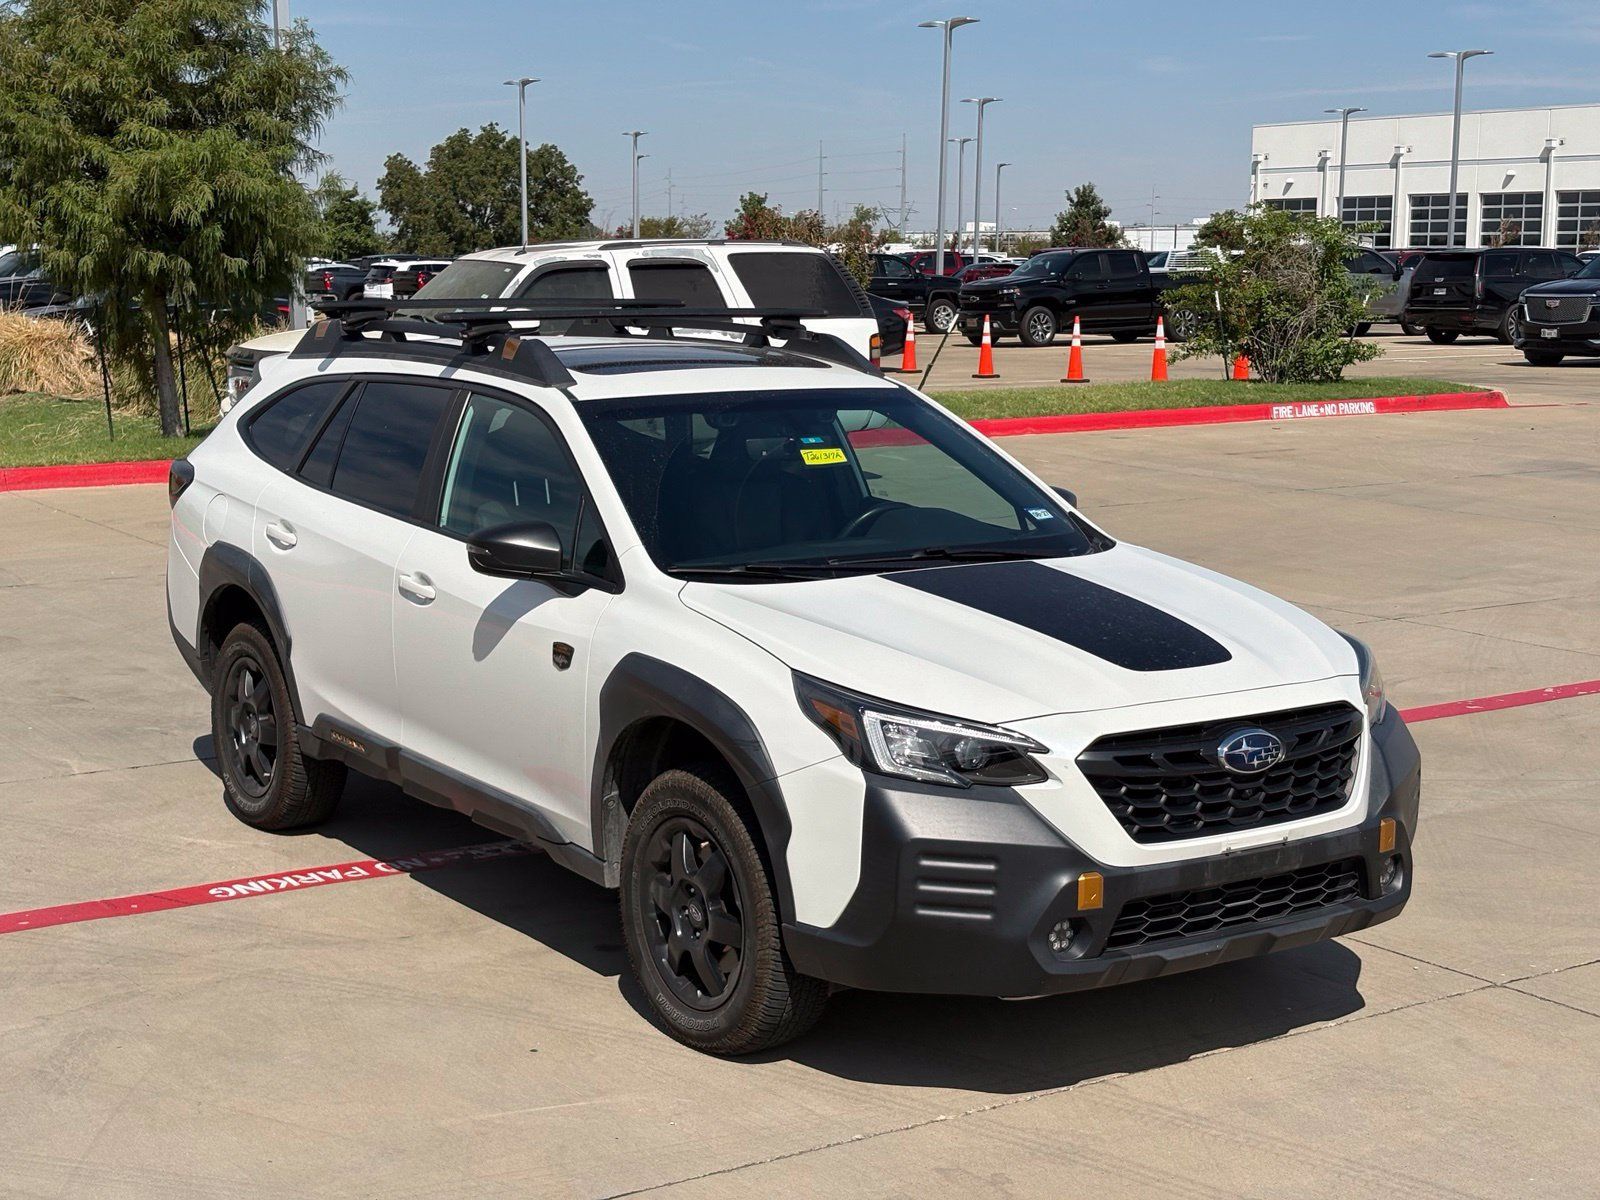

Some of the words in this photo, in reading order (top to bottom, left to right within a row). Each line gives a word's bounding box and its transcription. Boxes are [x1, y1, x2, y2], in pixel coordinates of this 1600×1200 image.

[1272, 405, 1294, 419] FIRE
[1295, 404, 1320, 417] LANE
[1324, 403, 1337, 416] NO
[1338, 401, 1375, 414] PARKING
[209, 866, 370, 898] PARKING
[656, 992, 721, 1031] YOKOHAMA
